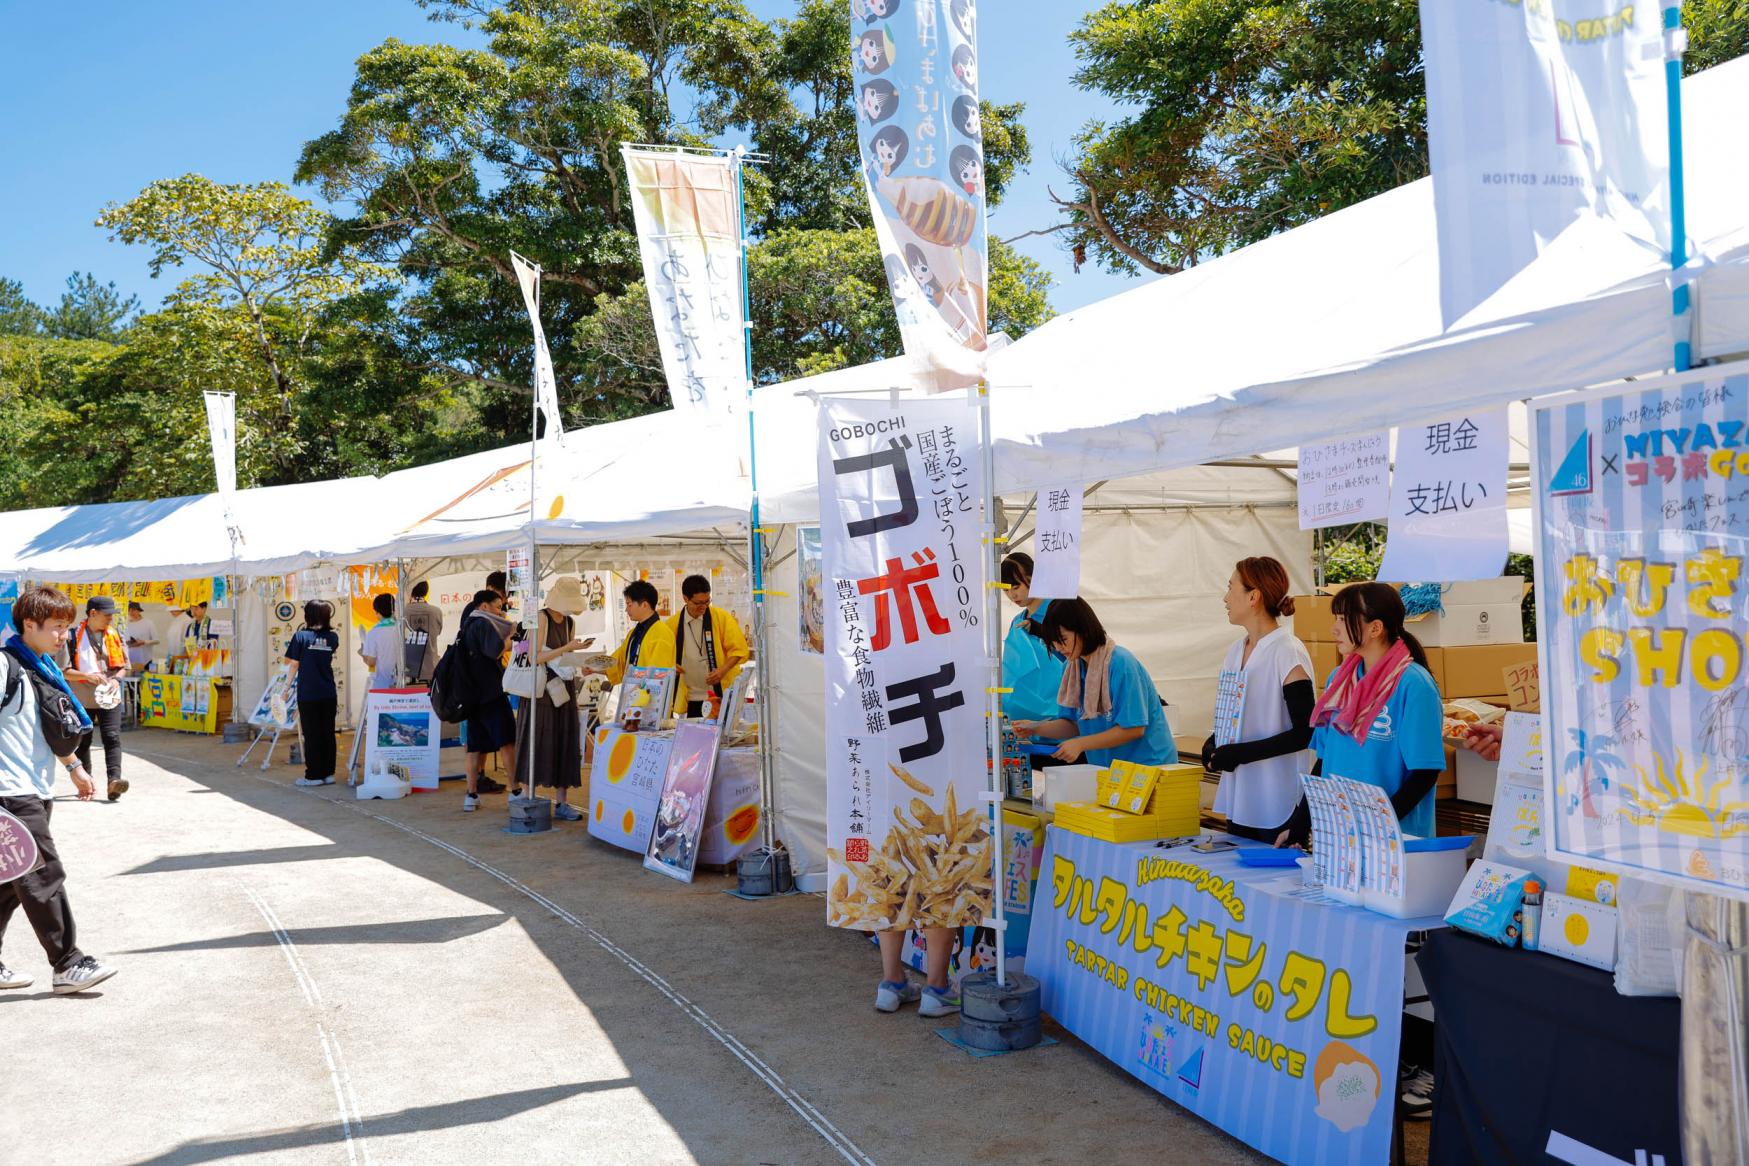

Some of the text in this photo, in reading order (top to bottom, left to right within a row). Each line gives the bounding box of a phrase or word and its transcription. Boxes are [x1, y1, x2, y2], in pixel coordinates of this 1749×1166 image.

[829, 415, 905, 443] GOBOCHI
[1425, 417, 1479, 456] 現金
[1624, 420, 1749, 459] MIYAZ
[938, 425, 973, 513] まるごと
[1048, 488, 1071, 512] 現金
[1405, 479, 1488, 517] 支払い
[1040, 532, 1074, 553] 支払い
[833, 433, 966, 764] ゴボチ
[836, 578, 888, 736] 豊富な食物繊維
[1579, 625, 1749, 692] SHO
[1053, 853, 1378, 1039] タルタルチキンのタレ
[1065, 938, 1308, 1080] TARTAR CHICKEN SAUCE
